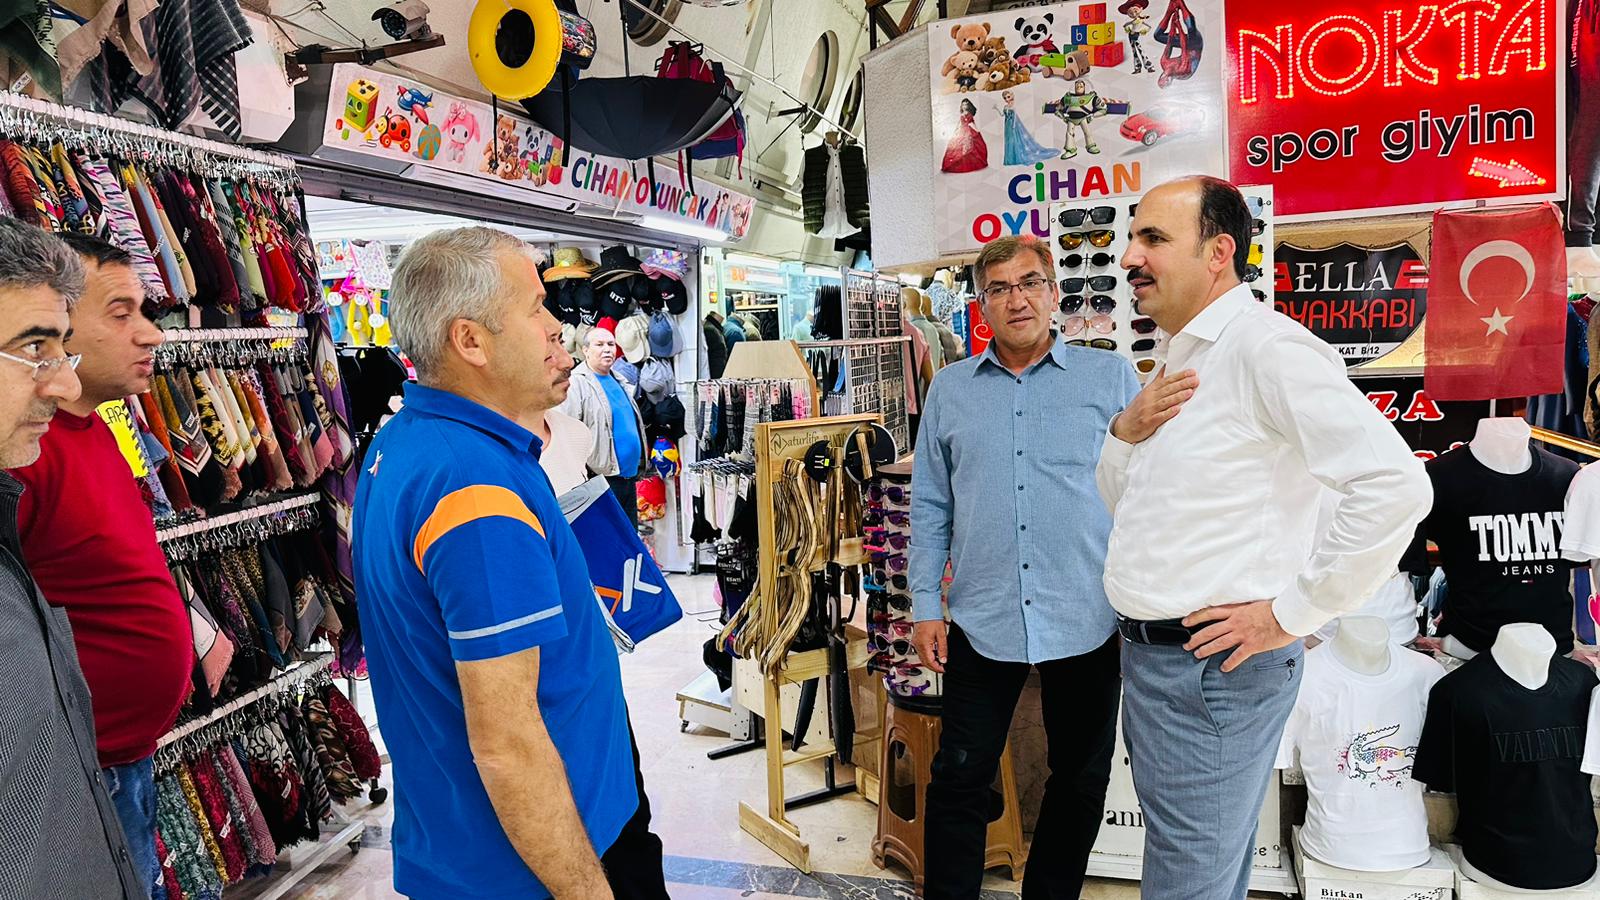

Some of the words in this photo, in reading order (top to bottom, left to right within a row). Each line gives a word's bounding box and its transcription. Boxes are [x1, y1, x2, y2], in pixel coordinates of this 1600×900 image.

[1238, 0, 1547, 104] NOKTA
[1246, 125, 1360, 173] spor
[1381, 104, 1535, 163] giyim
[1007, 161, 1142, 204] CİHAN
[1293, 260, 1393, 293] ELLA
[1338, 346, 1357, 356] KAT
[1502, 564, 1555, 576] JEANS
[1321, 888, 1364, 900] Birkan
